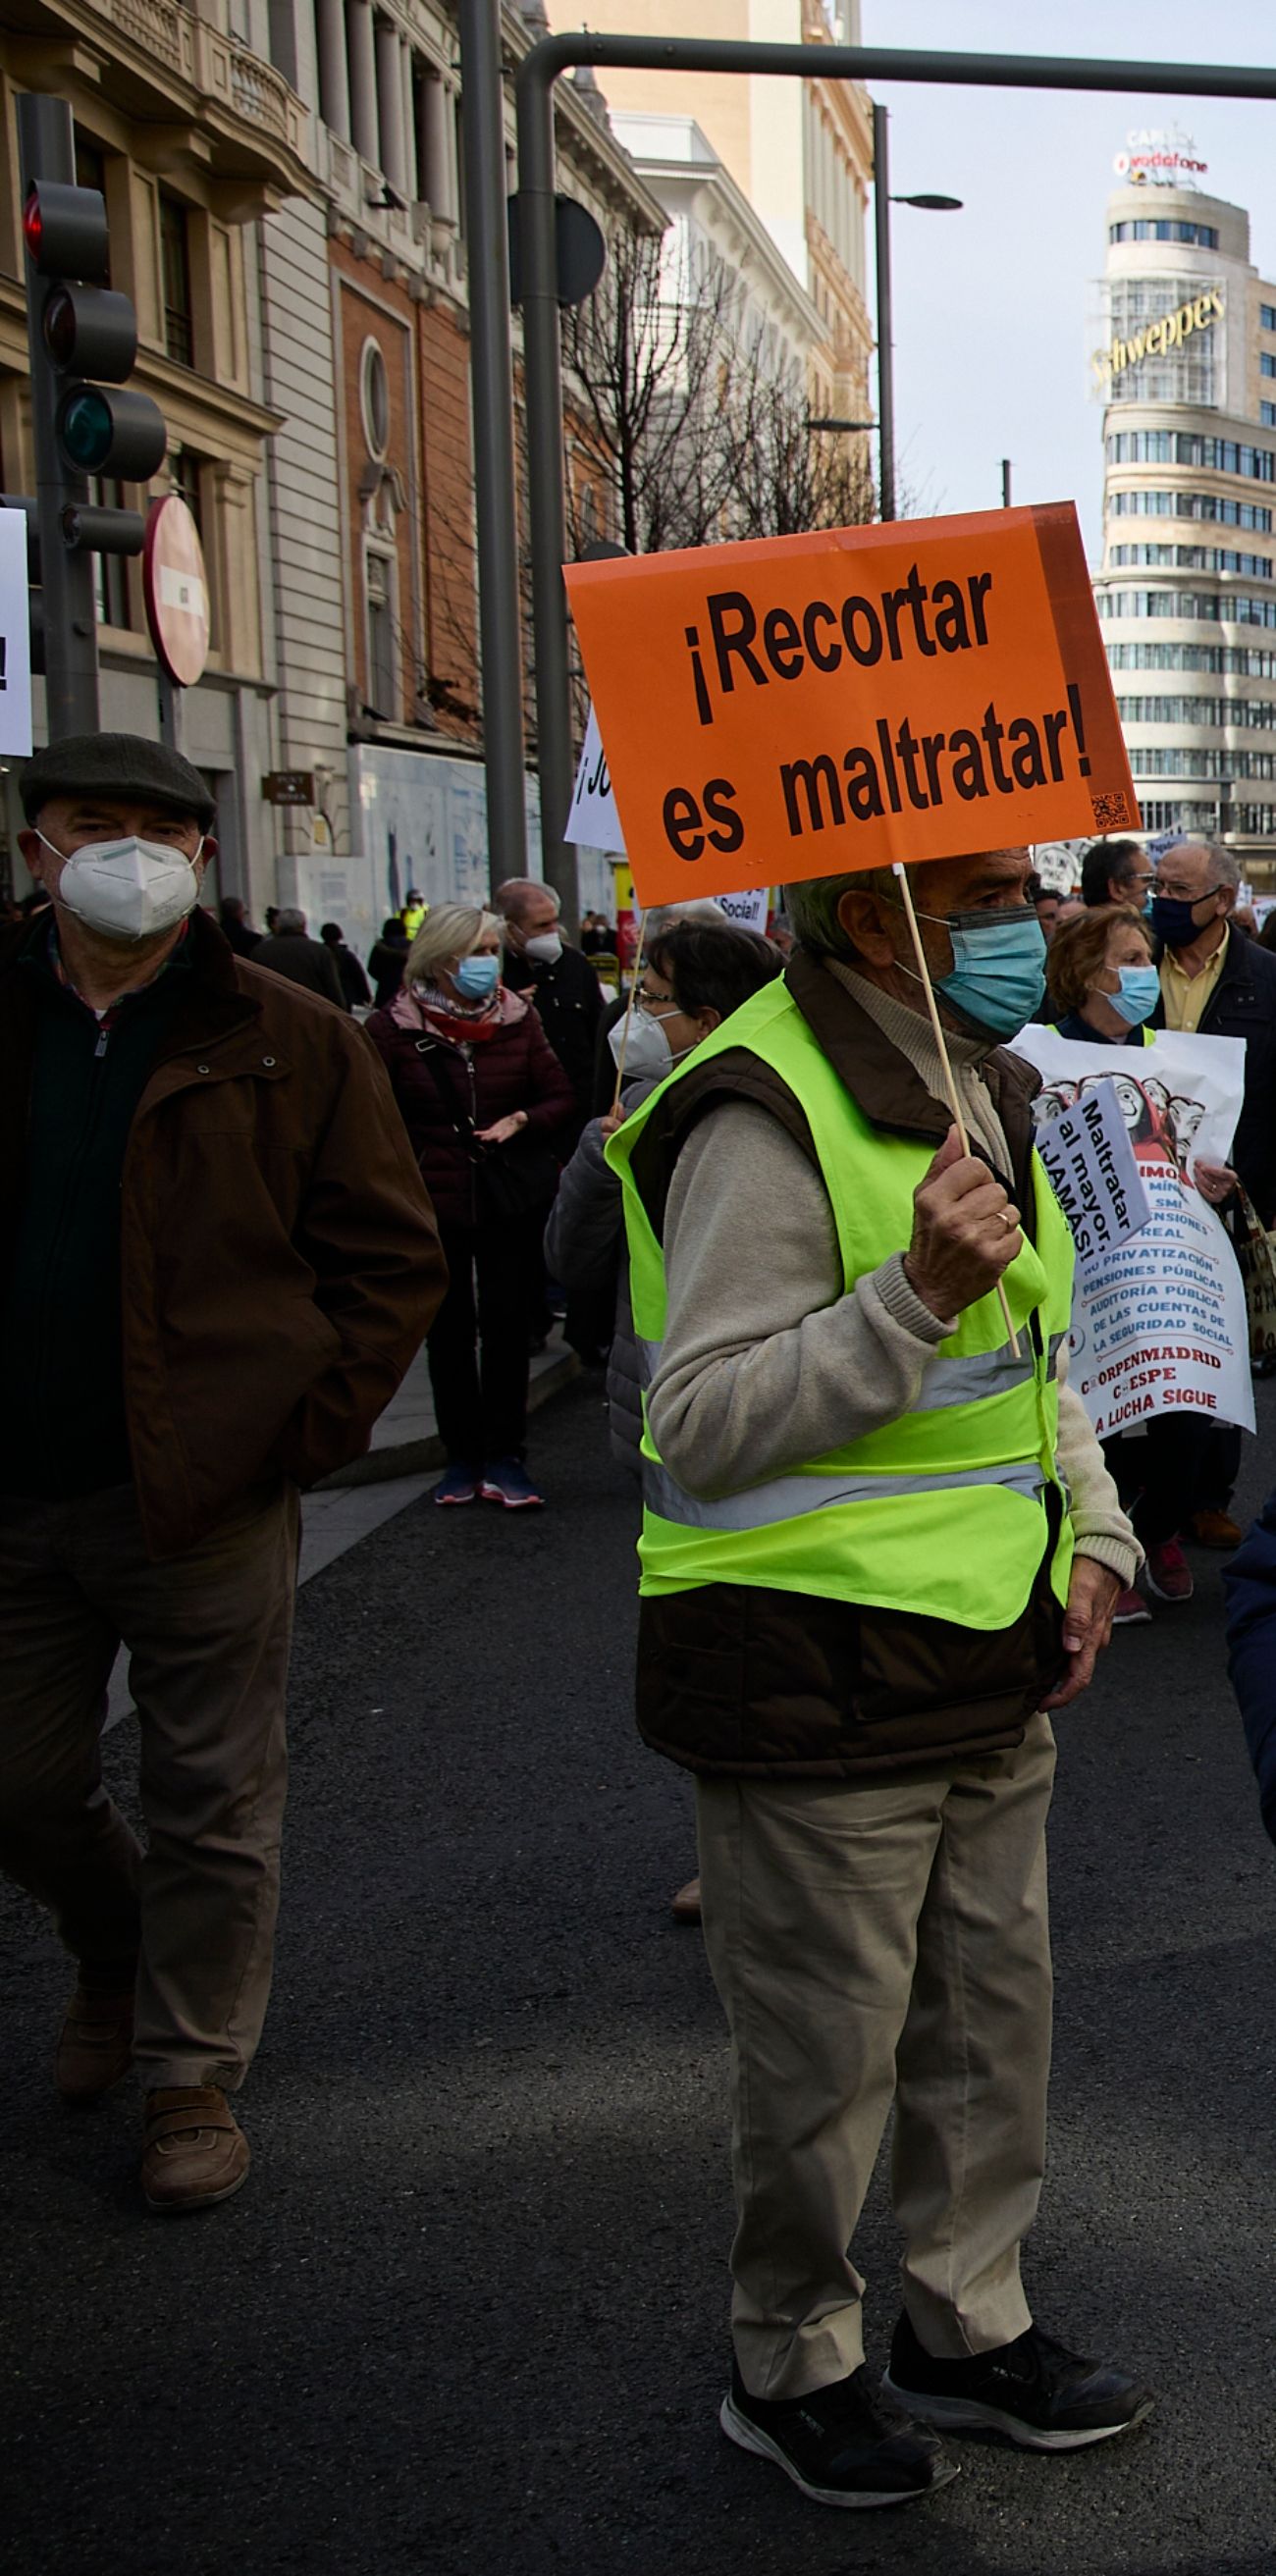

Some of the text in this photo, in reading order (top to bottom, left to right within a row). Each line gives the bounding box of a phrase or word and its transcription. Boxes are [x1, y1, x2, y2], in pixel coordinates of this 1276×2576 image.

[1130, 152, 1208, 174] vodafone
[1091, 285, 1224, 392] Schweppes
[684, 562, 992, 726] ¡Recortar
[663, 683, 1091, 861] es maltratar!
[1082, 1099, 1131, 1229] Maltratar
[1037, 1140, 1094, 1263] ¡JAMÁS!
[1058, 1121, 1112, 1252] al mayor,
[1155, 1197, 1183, 1209] SMI
[1141, 1227, 1185, 1238] REAL
[1150, 1212, 1208, 1235] NSIONES
[1103, 1247, 1213, 1272] PRIVATIZACIÓN
[1083, 1264, 1224, 1295] PENSIONES PÚBLICAS
[1090, 1284, 1219, 1316] AUDITORÍA PÚBLICA
[1093, 1302, 1225, 1334] DE LAS CUENTAS DE
[1092, 1319, 1233, 1353] LA SEGURIDAD SOCIAL
[1108, 1393, 1154, 1428] LUCHA
[1162, 1389, 1217, 1410] SIGUE
